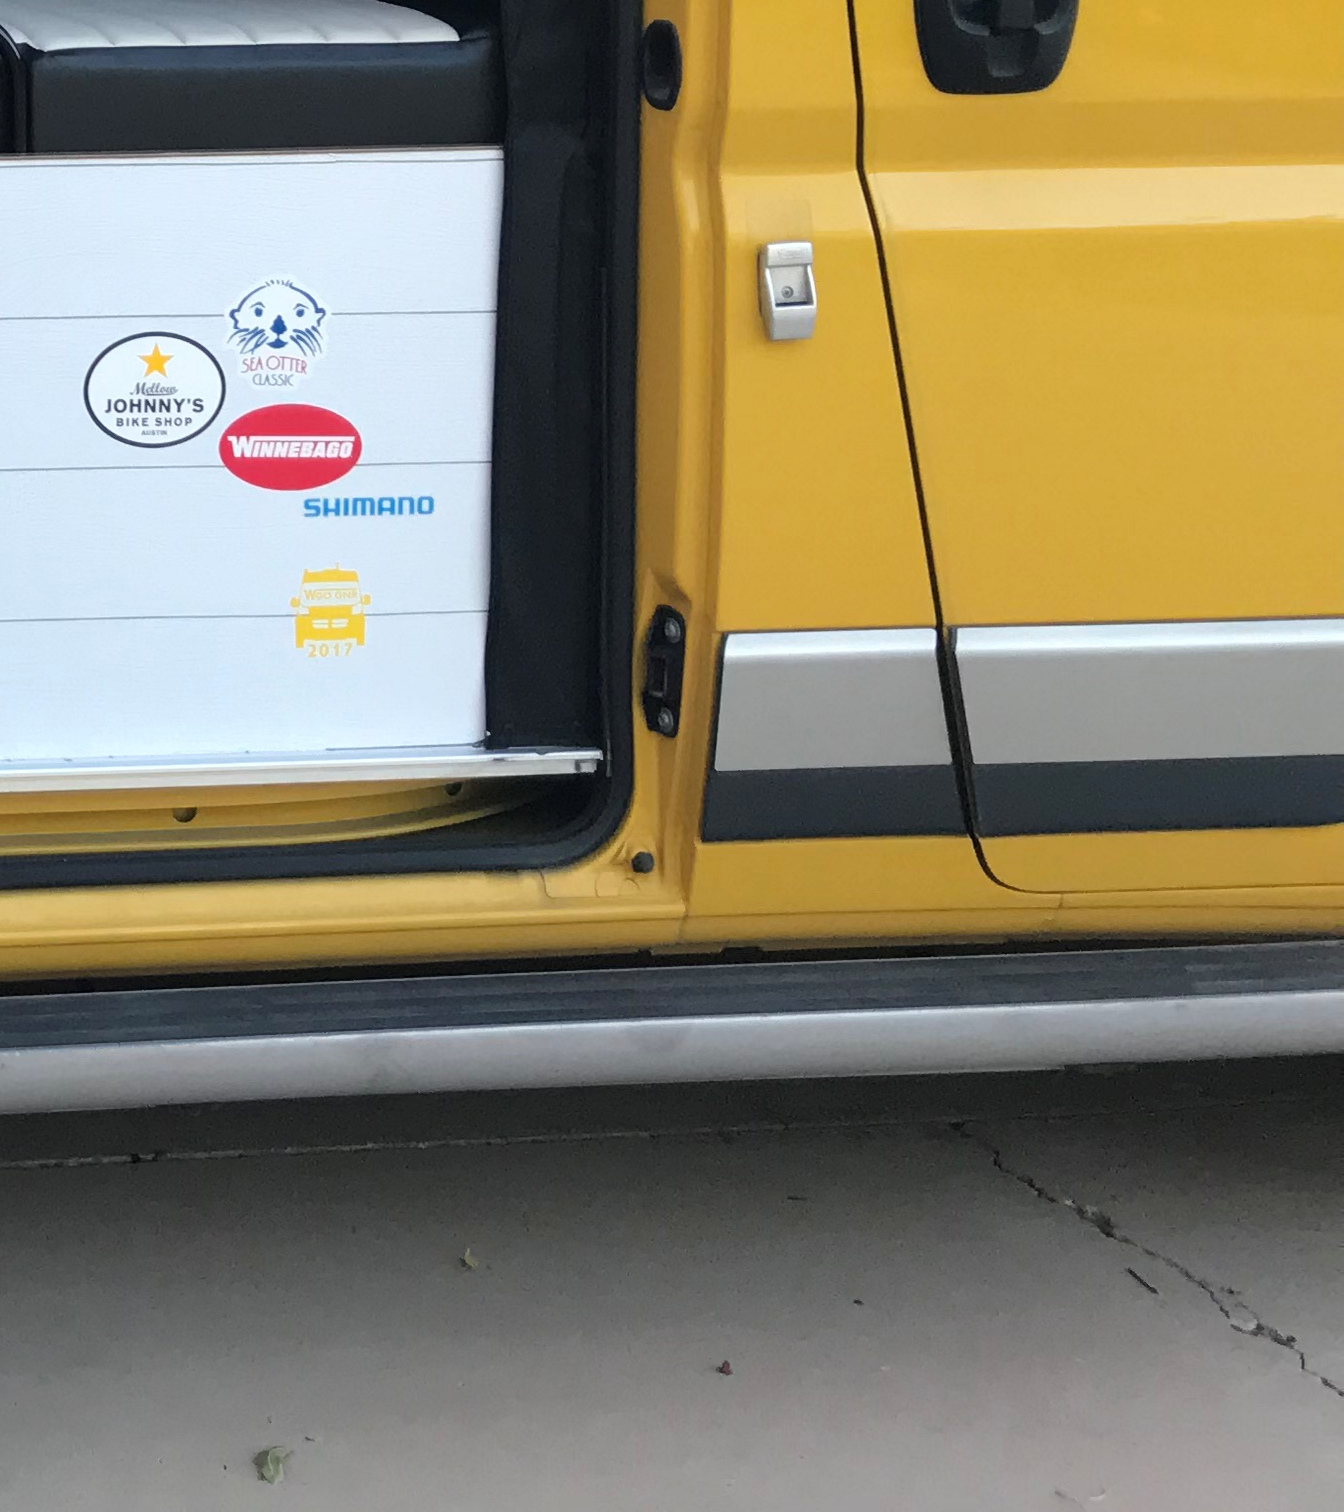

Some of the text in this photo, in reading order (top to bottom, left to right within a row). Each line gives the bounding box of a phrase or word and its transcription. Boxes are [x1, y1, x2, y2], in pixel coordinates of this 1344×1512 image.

[240, 355, 308, 375] SEA OTTER
[251, 373, 294, 387] CLASSIC
[129, 382, 179, 397] Mellow
[104, 398, 205, 414] JOHNNY'S
[115, 417, 193, 427] BIKE SHOP
[226, 435, 356, 459] WINNEBAGO
[303, 495, 435, 518] SHIMANO
[308, 642, 354, 658] 2017
